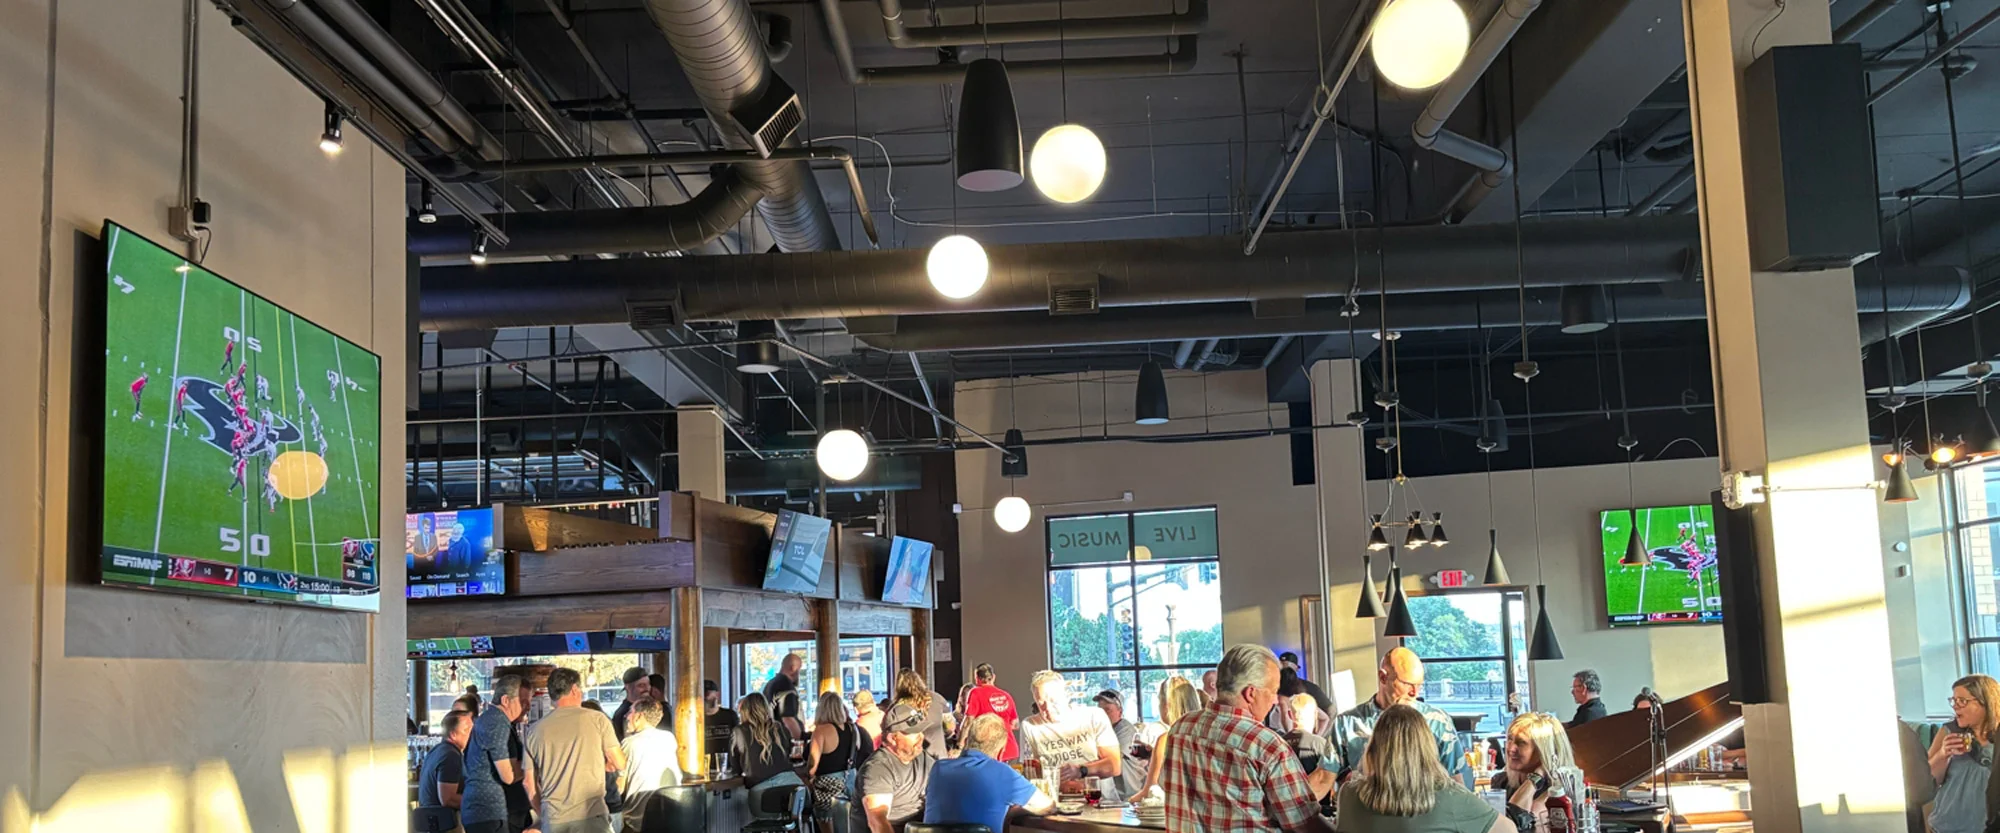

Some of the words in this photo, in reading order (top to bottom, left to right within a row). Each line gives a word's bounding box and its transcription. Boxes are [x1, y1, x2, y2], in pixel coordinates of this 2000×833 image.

[220, 527, 270, 556] 50
[224, 568, 234, 581] 7
[243, 570, 257, 584] 10
[1442, 570, 1463, 587] EXIT
[311, 582, 331, 593] 15:00
[1043, 739, 1064, 751] YES
[1066, 731, 1088, 746] WAY
